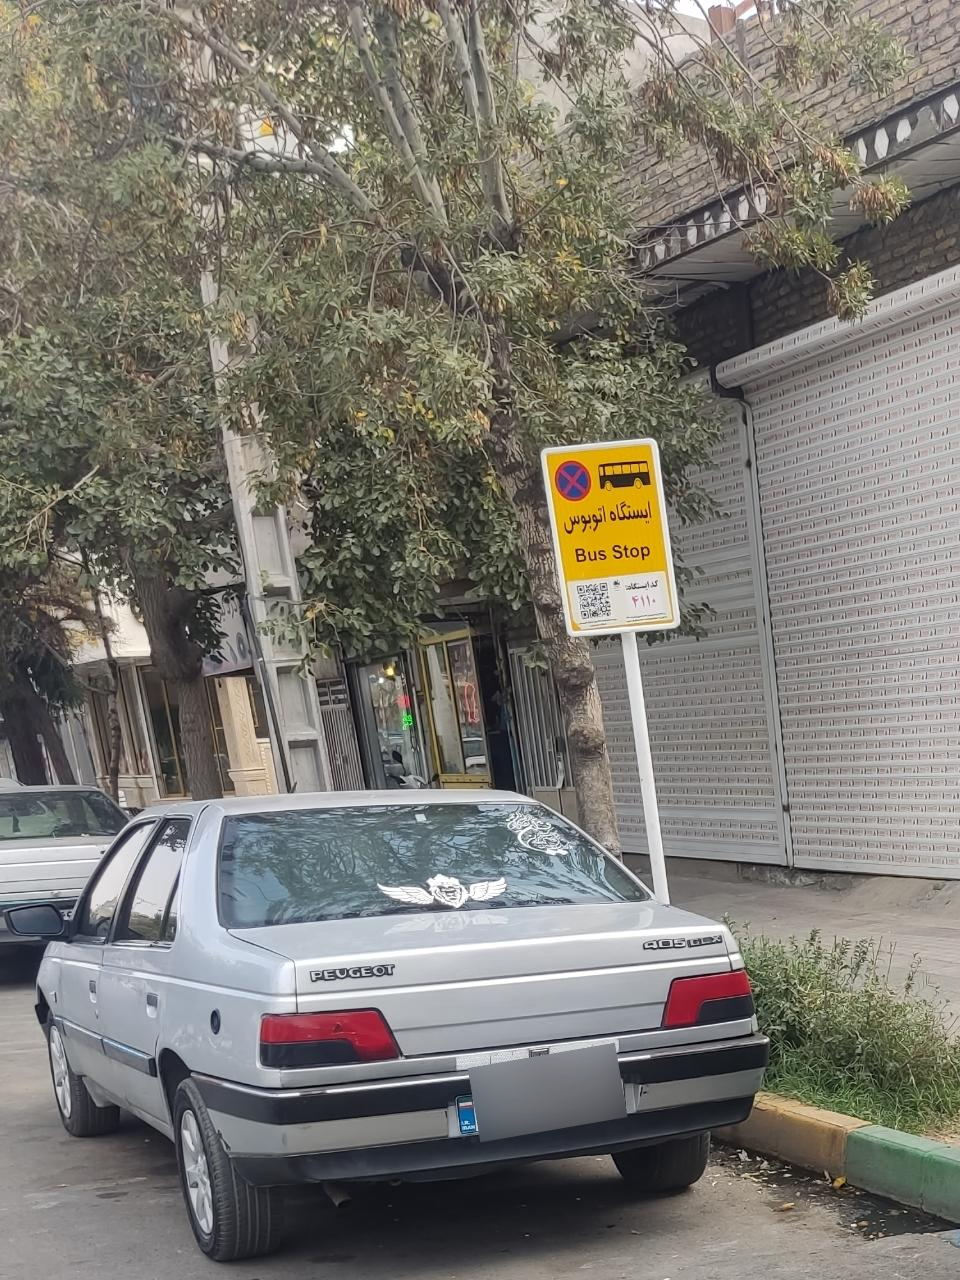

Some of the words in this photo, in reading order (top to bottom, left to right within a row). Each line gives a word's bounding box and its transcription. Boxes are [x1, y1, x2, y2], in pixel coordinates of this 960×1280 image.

[563, 505, 607, 535] اتوبوس
[609, 500, 652, 525] ایستگاه
[575, 547, 607, 563] Bus
[612, 544, 651, 560] Stop
[631, 594, 656, 608] ۴۱۱۰
[643, 937, 686, 951] 405
[309, 963, 396, 982] PEUGEOT
